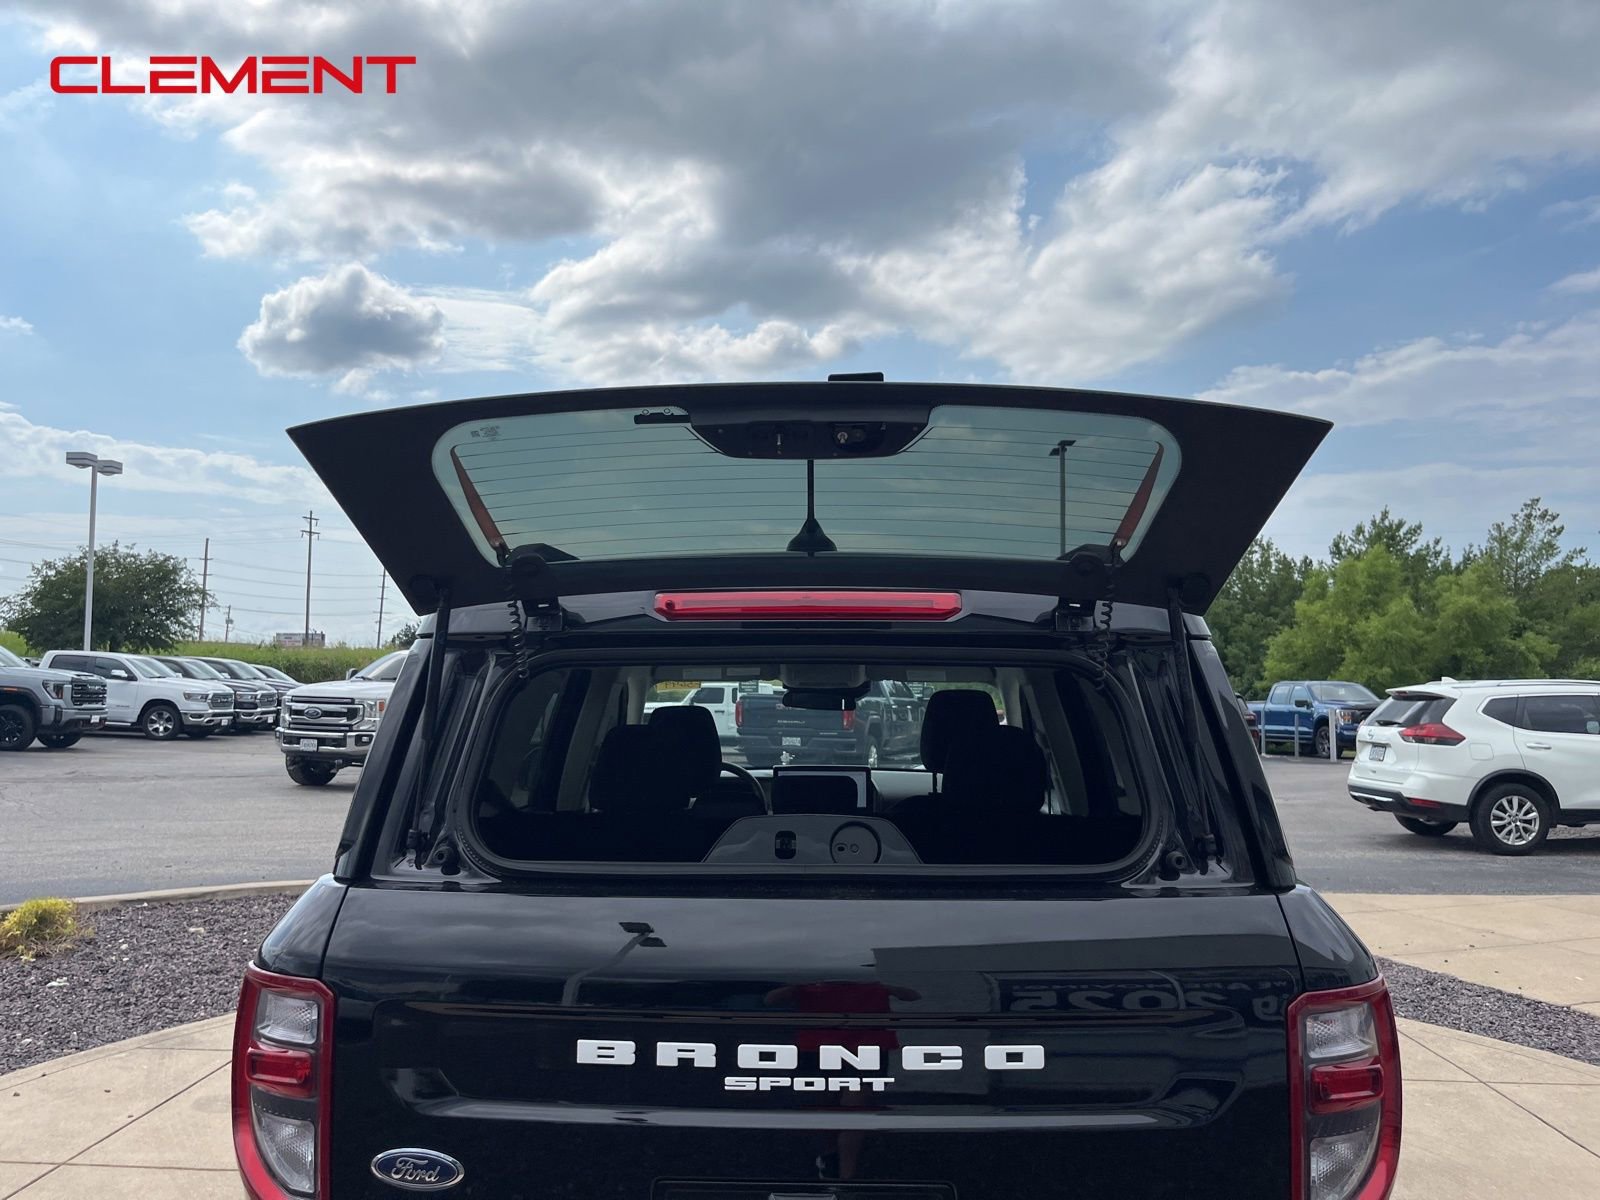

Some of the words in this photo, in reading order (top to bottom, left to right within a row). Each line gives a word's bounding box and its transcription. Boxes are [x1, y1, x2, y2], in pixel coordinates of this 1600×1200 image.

[576, 1039, 1045, 1070] BRONCO
[724, 1076, 895, 1092] SPORT
[391, 1157, 440, 1182] Ford
